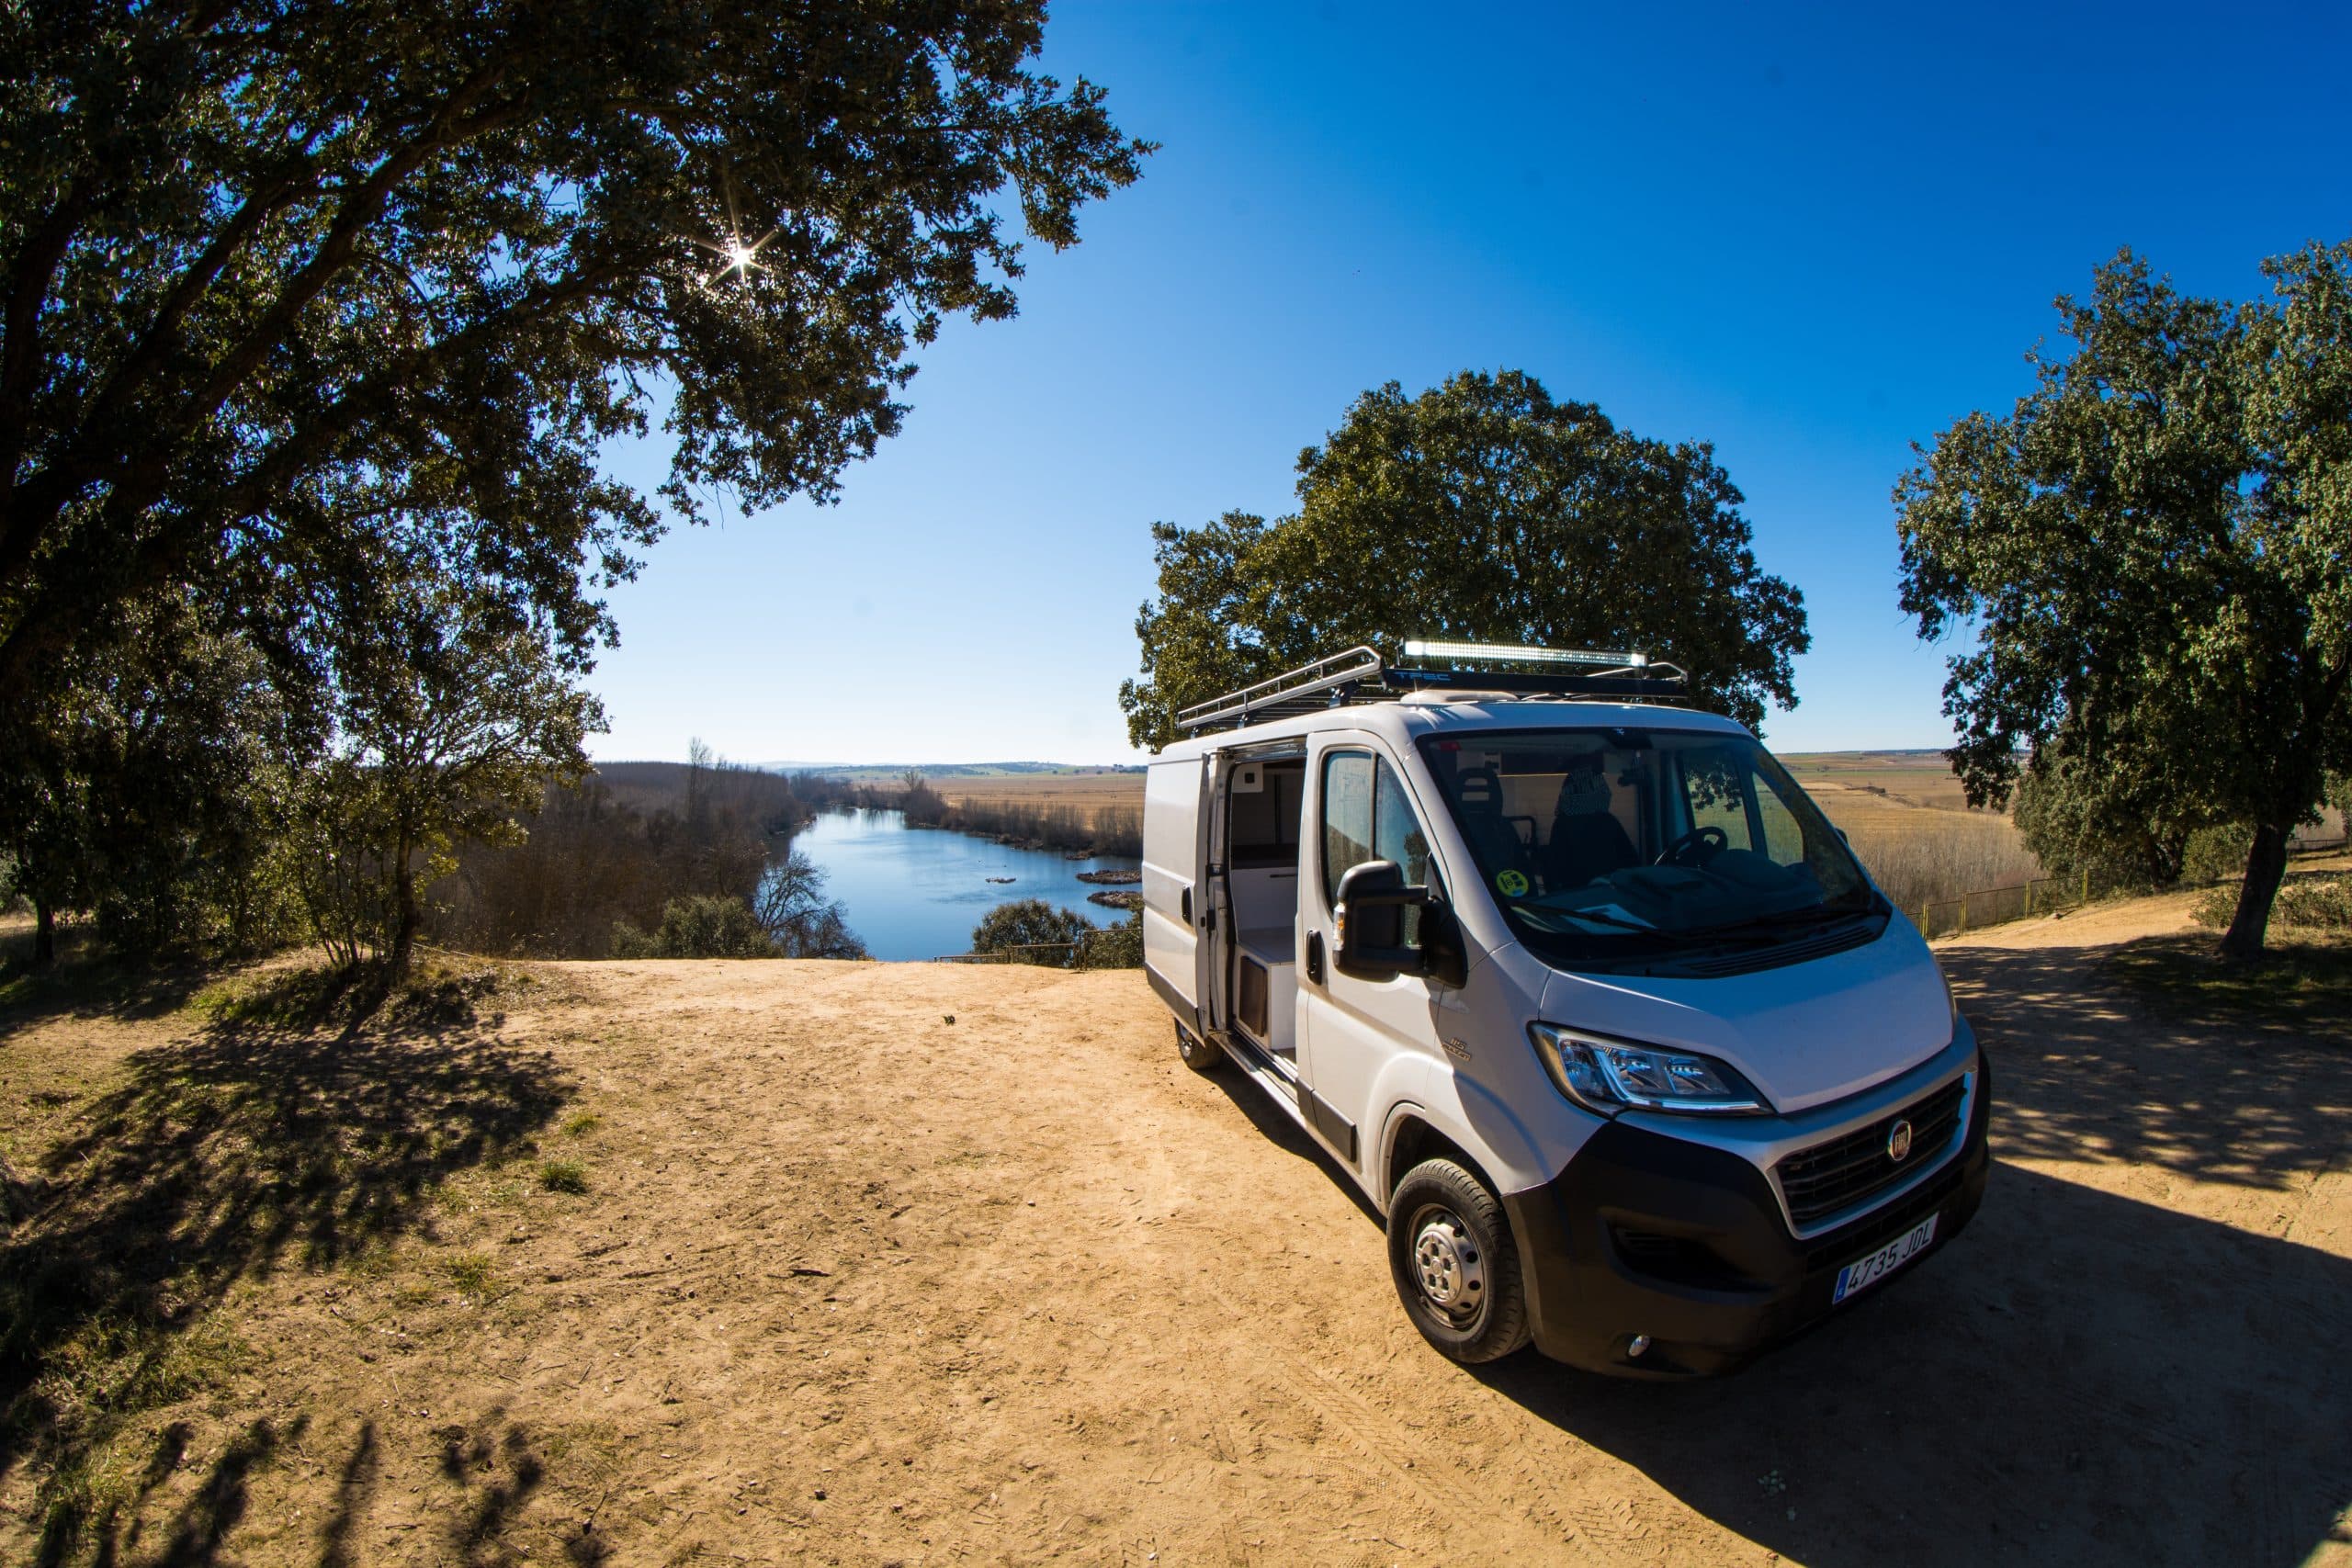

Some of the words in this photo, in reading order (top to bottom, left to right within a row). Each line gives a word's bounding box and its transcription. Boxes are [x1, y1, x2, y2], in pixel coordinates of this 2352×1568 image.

[1894, 1131, 1907, 1153] FIAT
[1848, 1243, 1899, 1290] 4735
[1902, 1223, 1930, 1258] JDL
